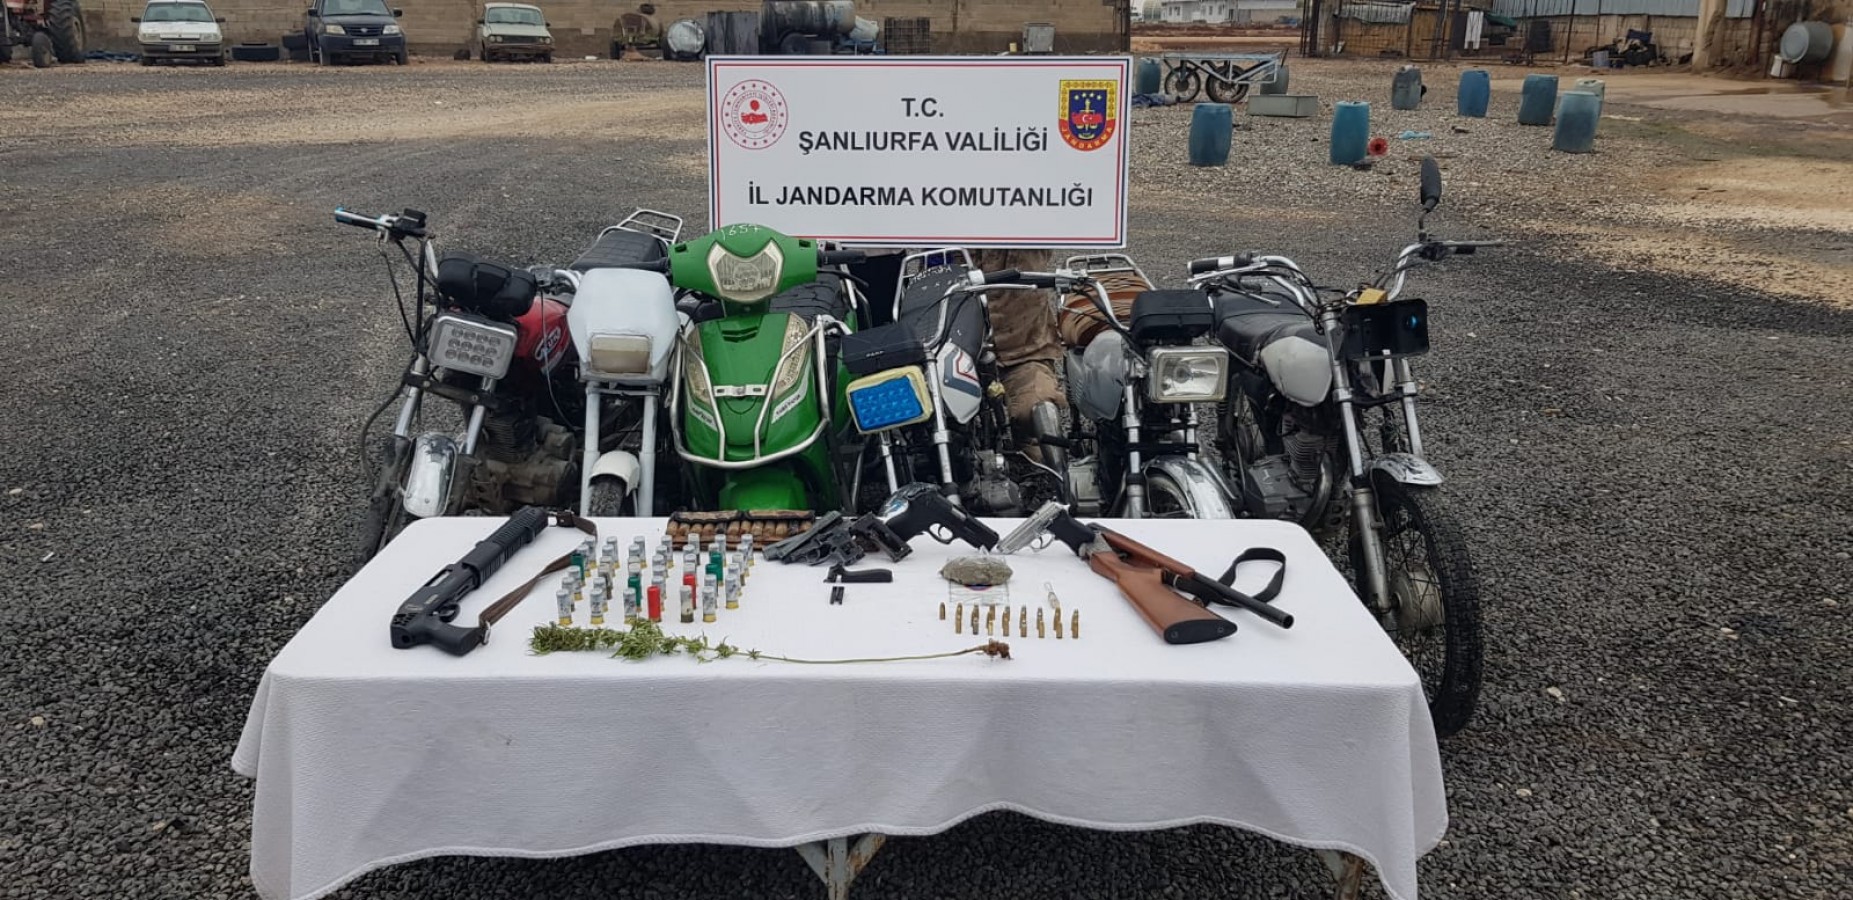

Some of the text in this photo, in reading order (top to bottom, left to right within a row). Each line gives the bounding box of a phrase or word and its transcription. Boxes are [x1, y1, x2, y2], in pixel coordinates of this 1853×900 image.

[900, 97, 944, 118] T.C.
[798, 126, 1048, 155] ŞANLIURFA VALİLİĞİ
[1061, 126, 1113, 149] JANDARMA
[748, 180, 1092, 206] İL JANDARMA KOMUTANLIĞI
